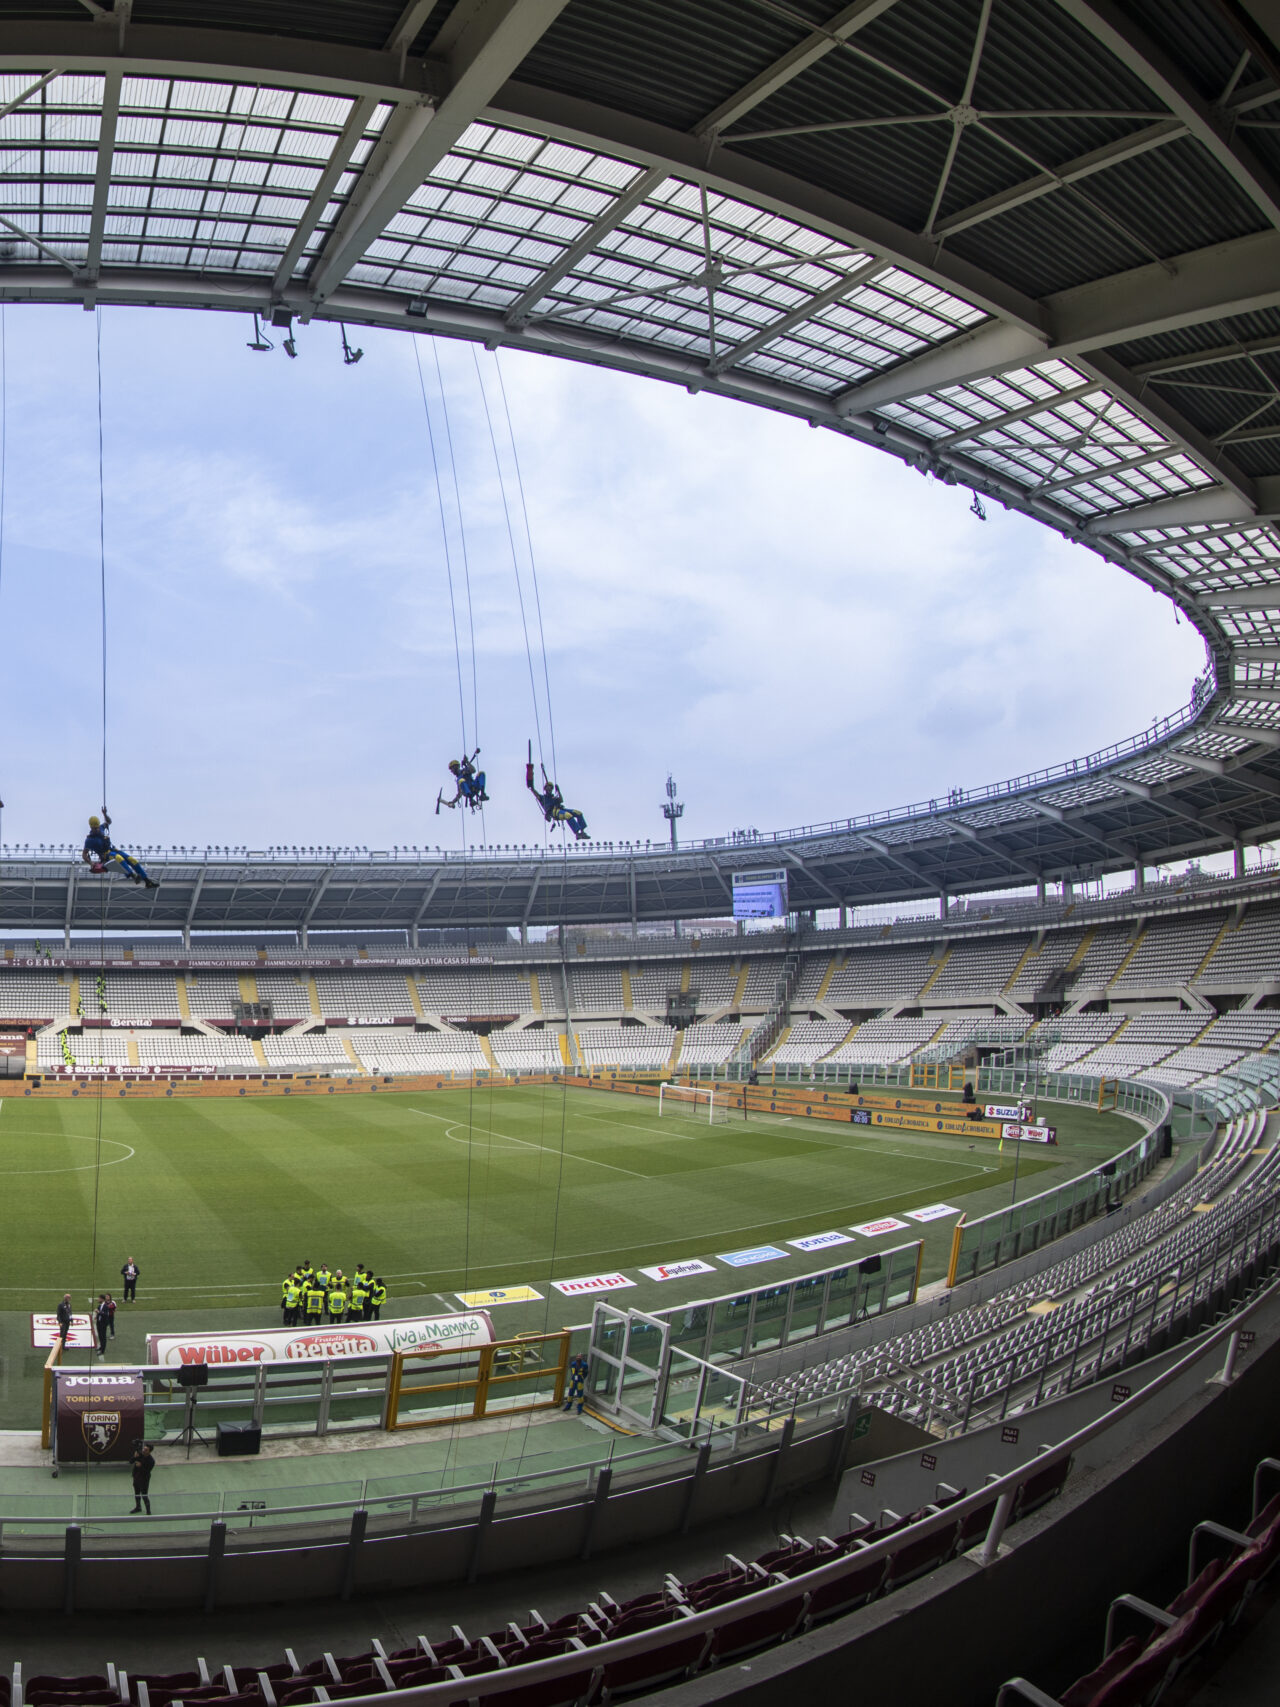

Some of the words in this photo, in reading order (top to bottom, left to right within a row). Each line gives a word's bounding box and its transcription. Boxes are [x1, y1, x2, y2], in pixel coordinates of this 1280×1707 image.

[26, 958, 66, 967] GERLA
[470, 956, 494, 964] MISURA
[111, 1018, 152, 1027] Beretta
[357, 1017, 395, 1025] SUZUKI
[559, 1275, 627, 1292] inalpi
[384, 1326, 417, 1351] Viva
[418, 1331, 427, 1342] la
[426, 1317, 480, 1340] Mamma
[290, 1337, 375, 1359] Beretta
[178, 1345, 265, 1366] Wüber
[65, 1395, 101, 1403] TORINO
